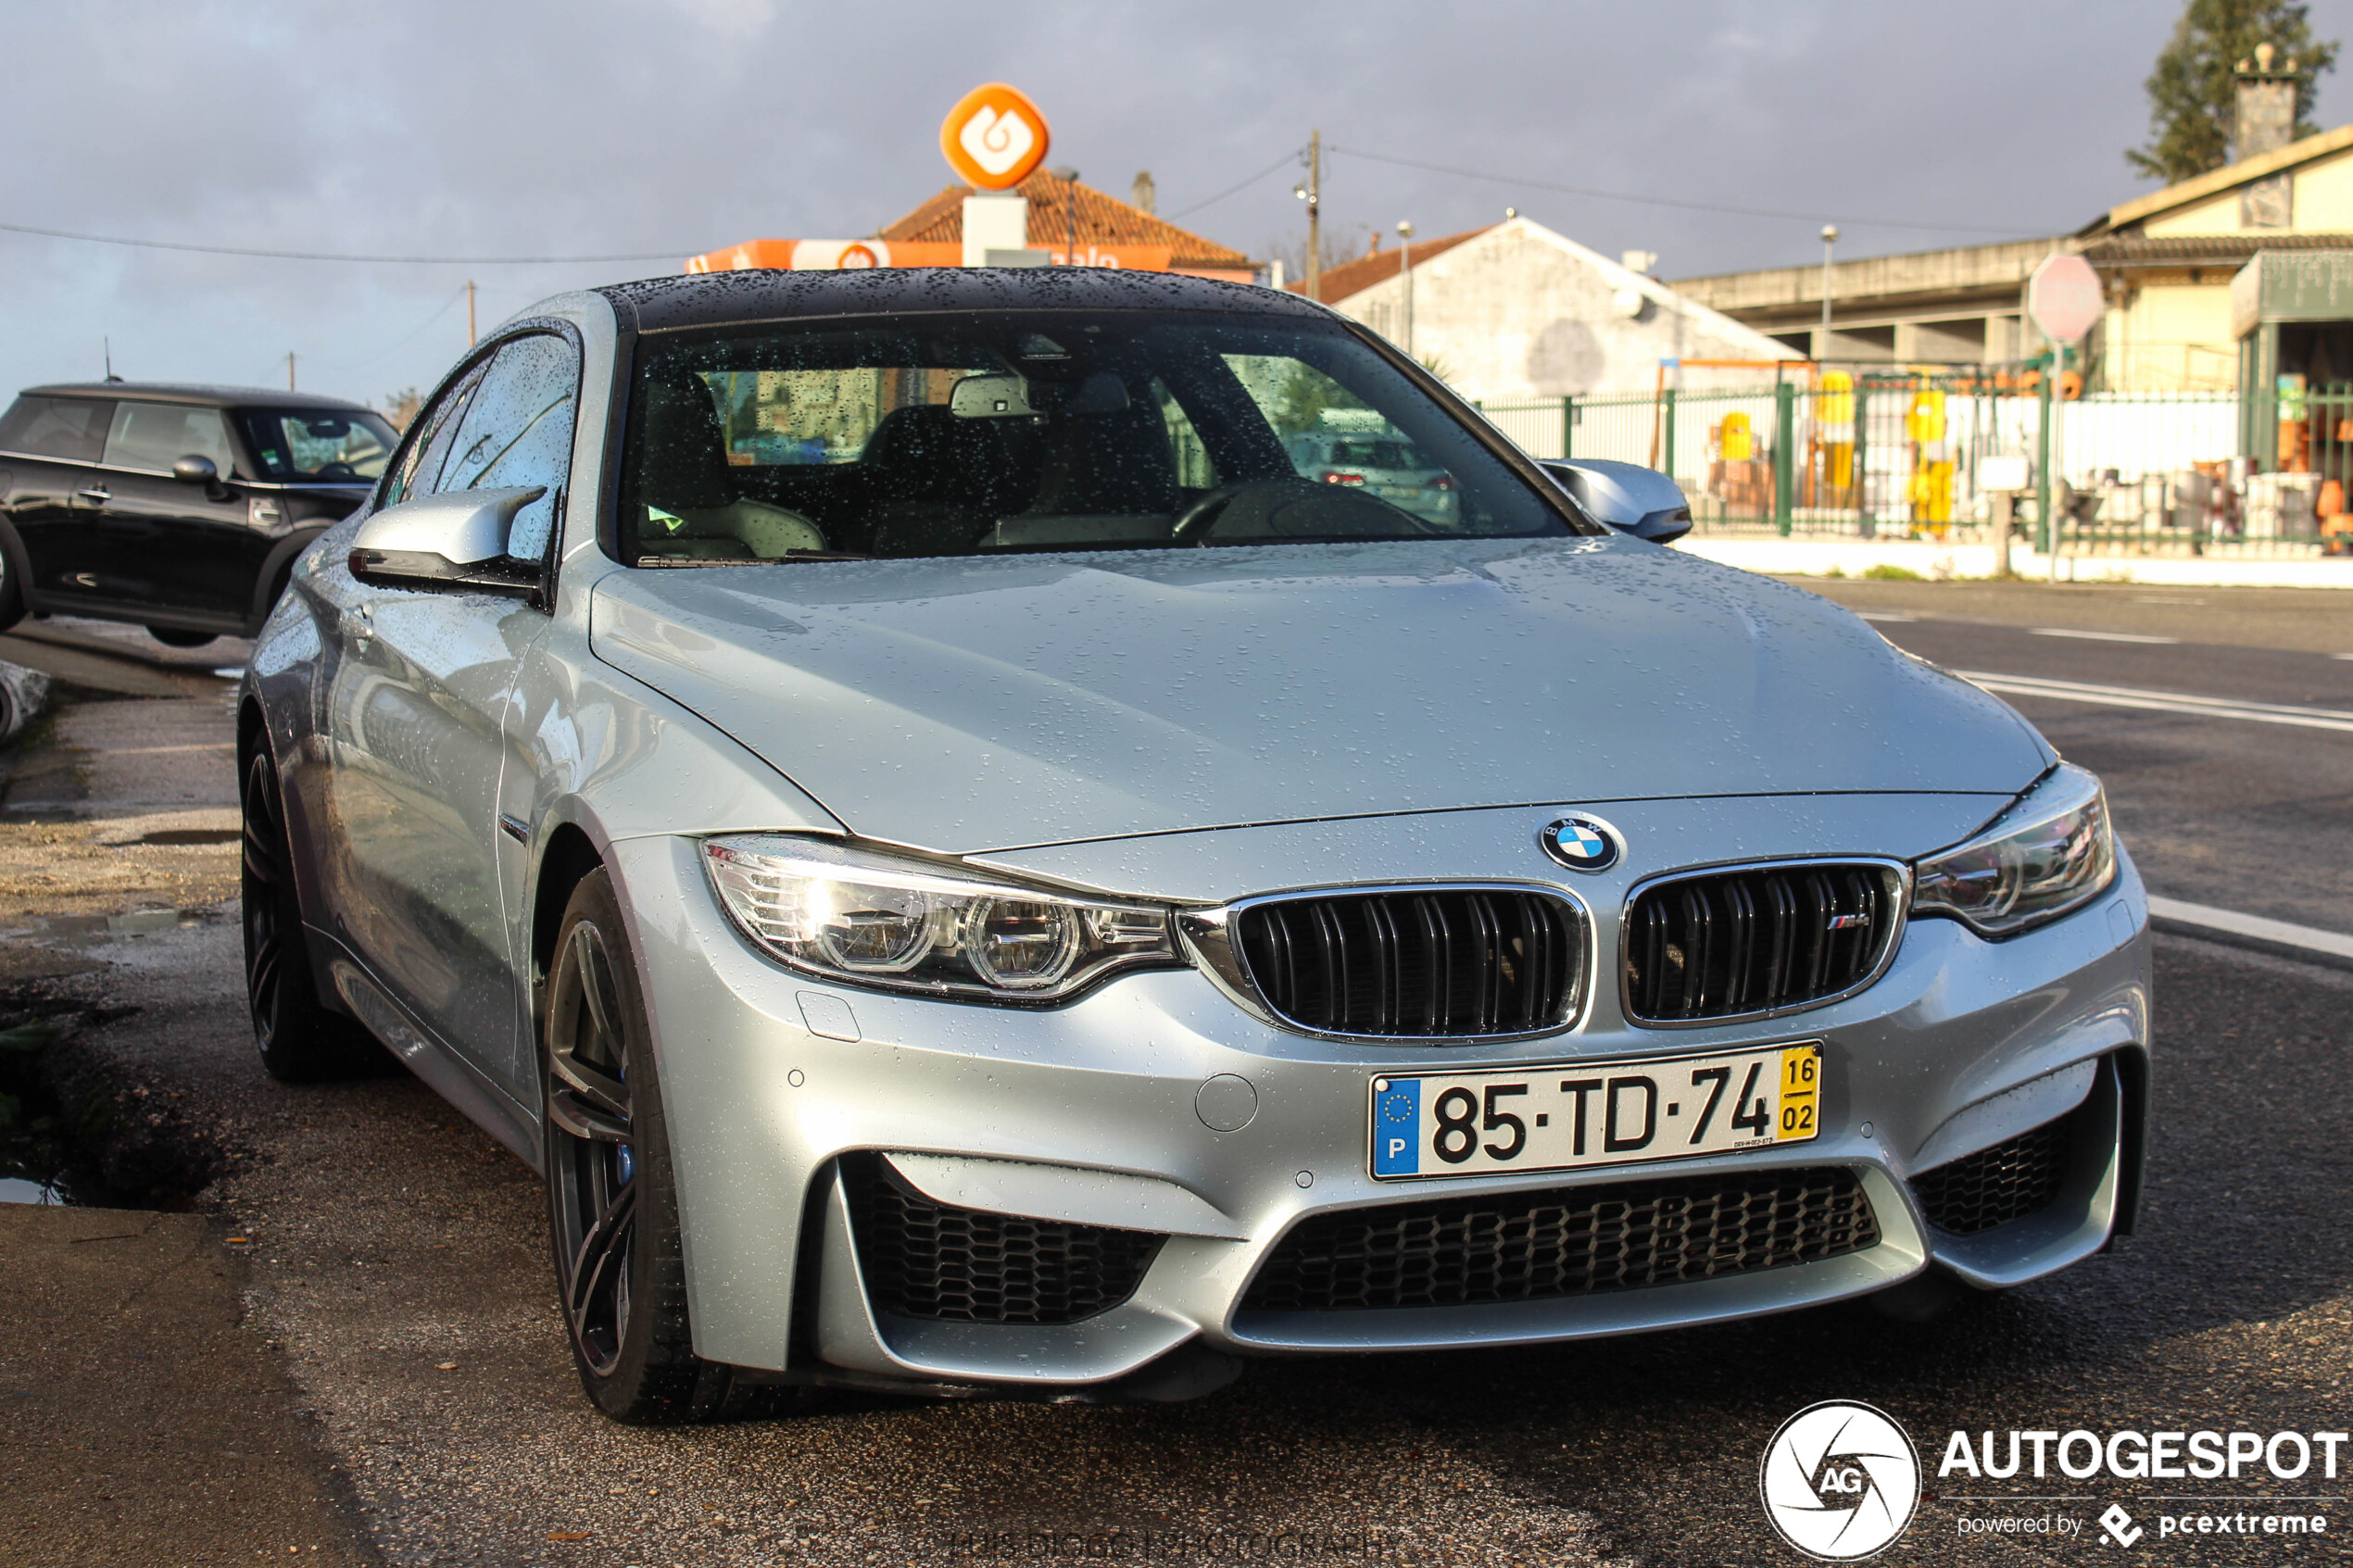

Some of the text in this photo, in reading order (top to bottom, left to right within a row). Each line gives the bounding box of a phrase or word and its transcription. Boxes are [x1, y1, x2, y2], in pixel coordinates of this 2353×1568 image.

[1544, 819, 1602, 836] BMW
[1789, 1059, 1815, 1084] 16
[1782, 1105, 1812, 1131] 02
[1389, 1138, 1406, 1159] P
